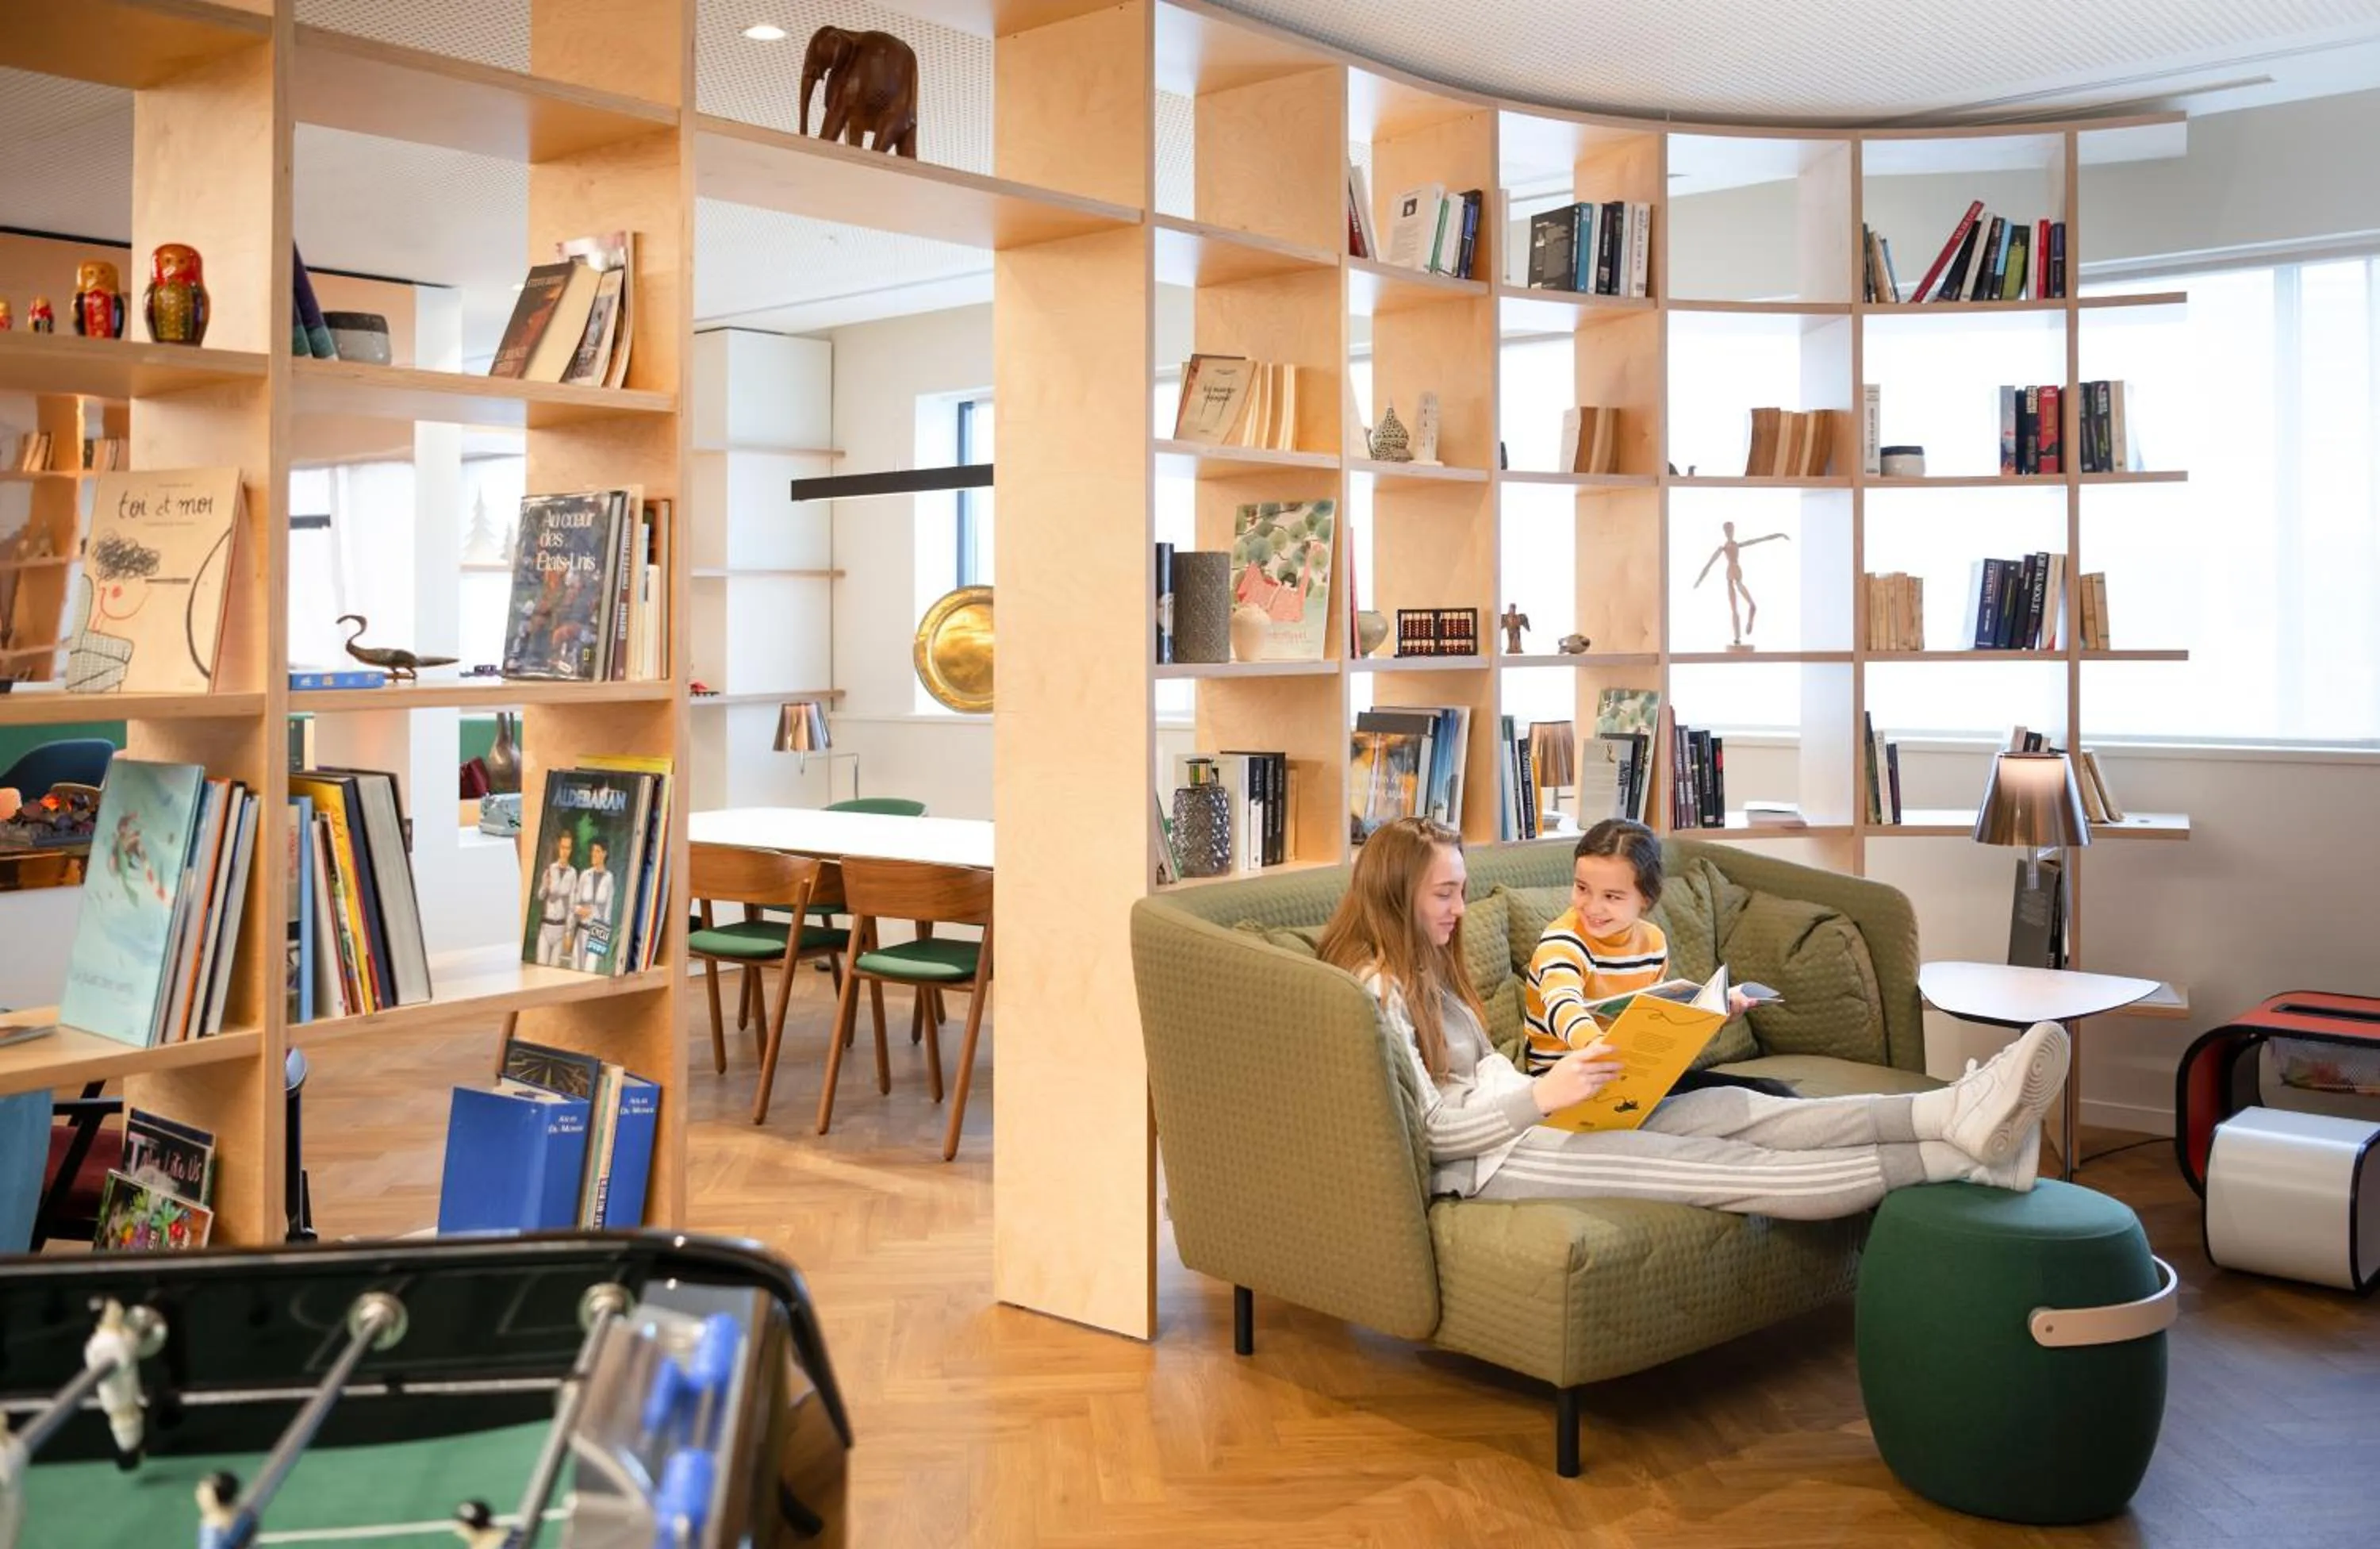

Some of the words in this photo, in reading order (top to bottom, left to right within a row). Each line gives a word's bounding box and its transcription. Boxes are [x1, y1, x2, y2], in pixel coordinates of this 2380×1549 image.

[118, 490, 147, 518] toi
[155, 493, 171, 516] et
[176, 496, 213, 517] moi
[539, 529, 564, 548] des
